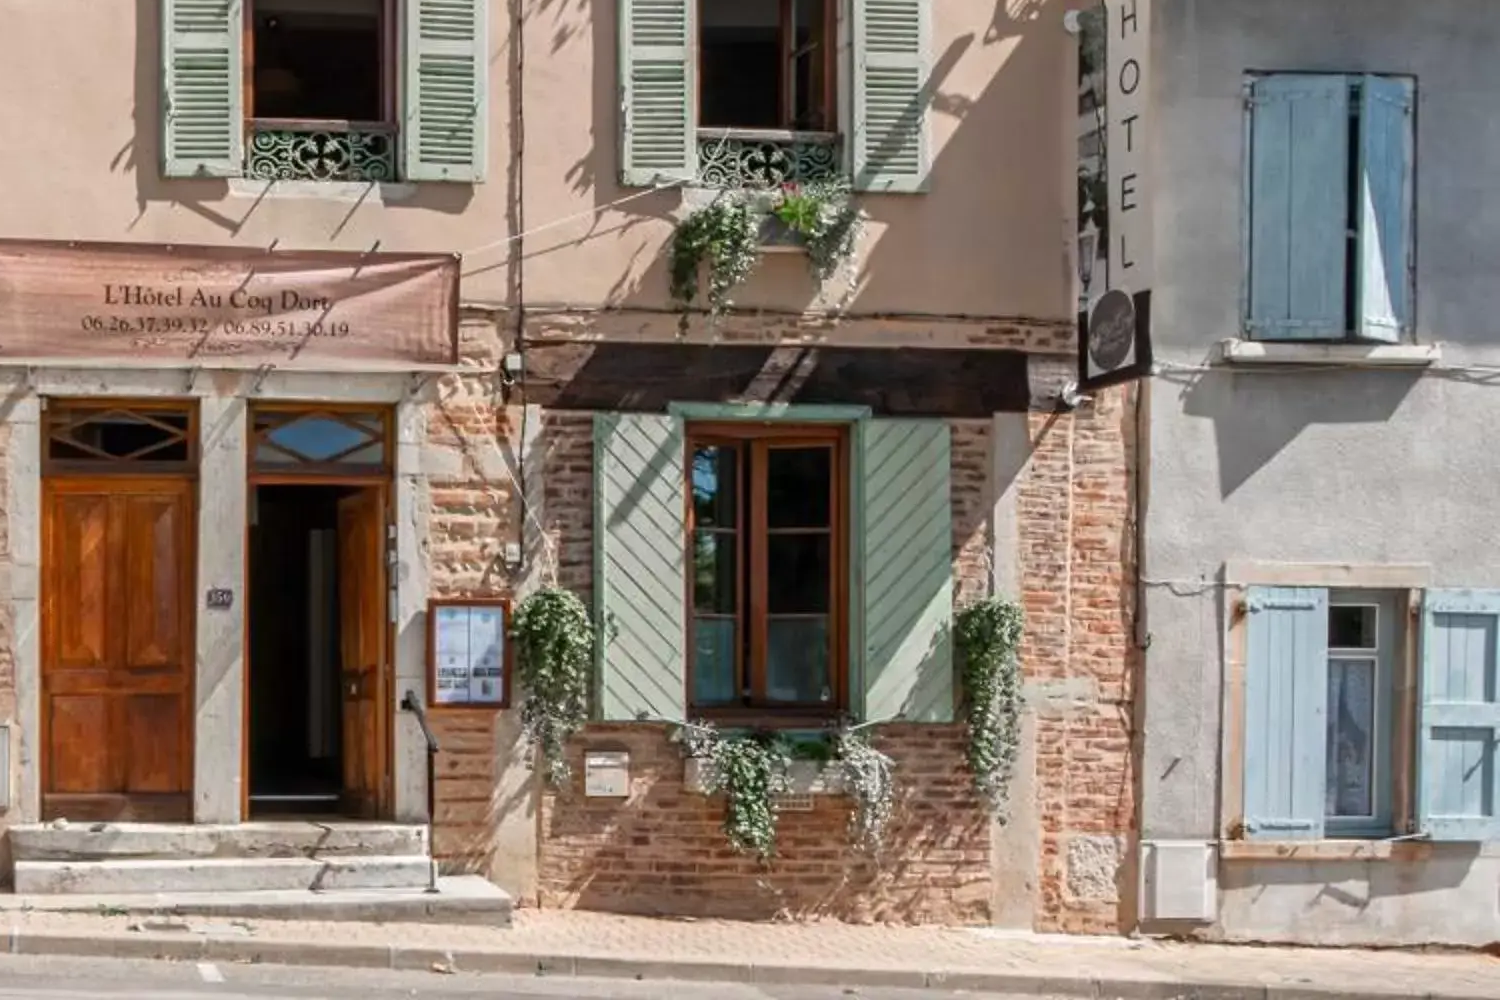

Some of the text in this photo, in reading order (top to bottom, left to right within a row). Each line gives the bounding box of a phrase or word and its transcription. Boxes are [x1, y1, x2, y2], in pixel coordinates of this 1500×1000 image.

[104, 284, 182, 307] L'Hôtel
[190, 287, 221, 308] Au
[228, 287, 274, 315] Coq
